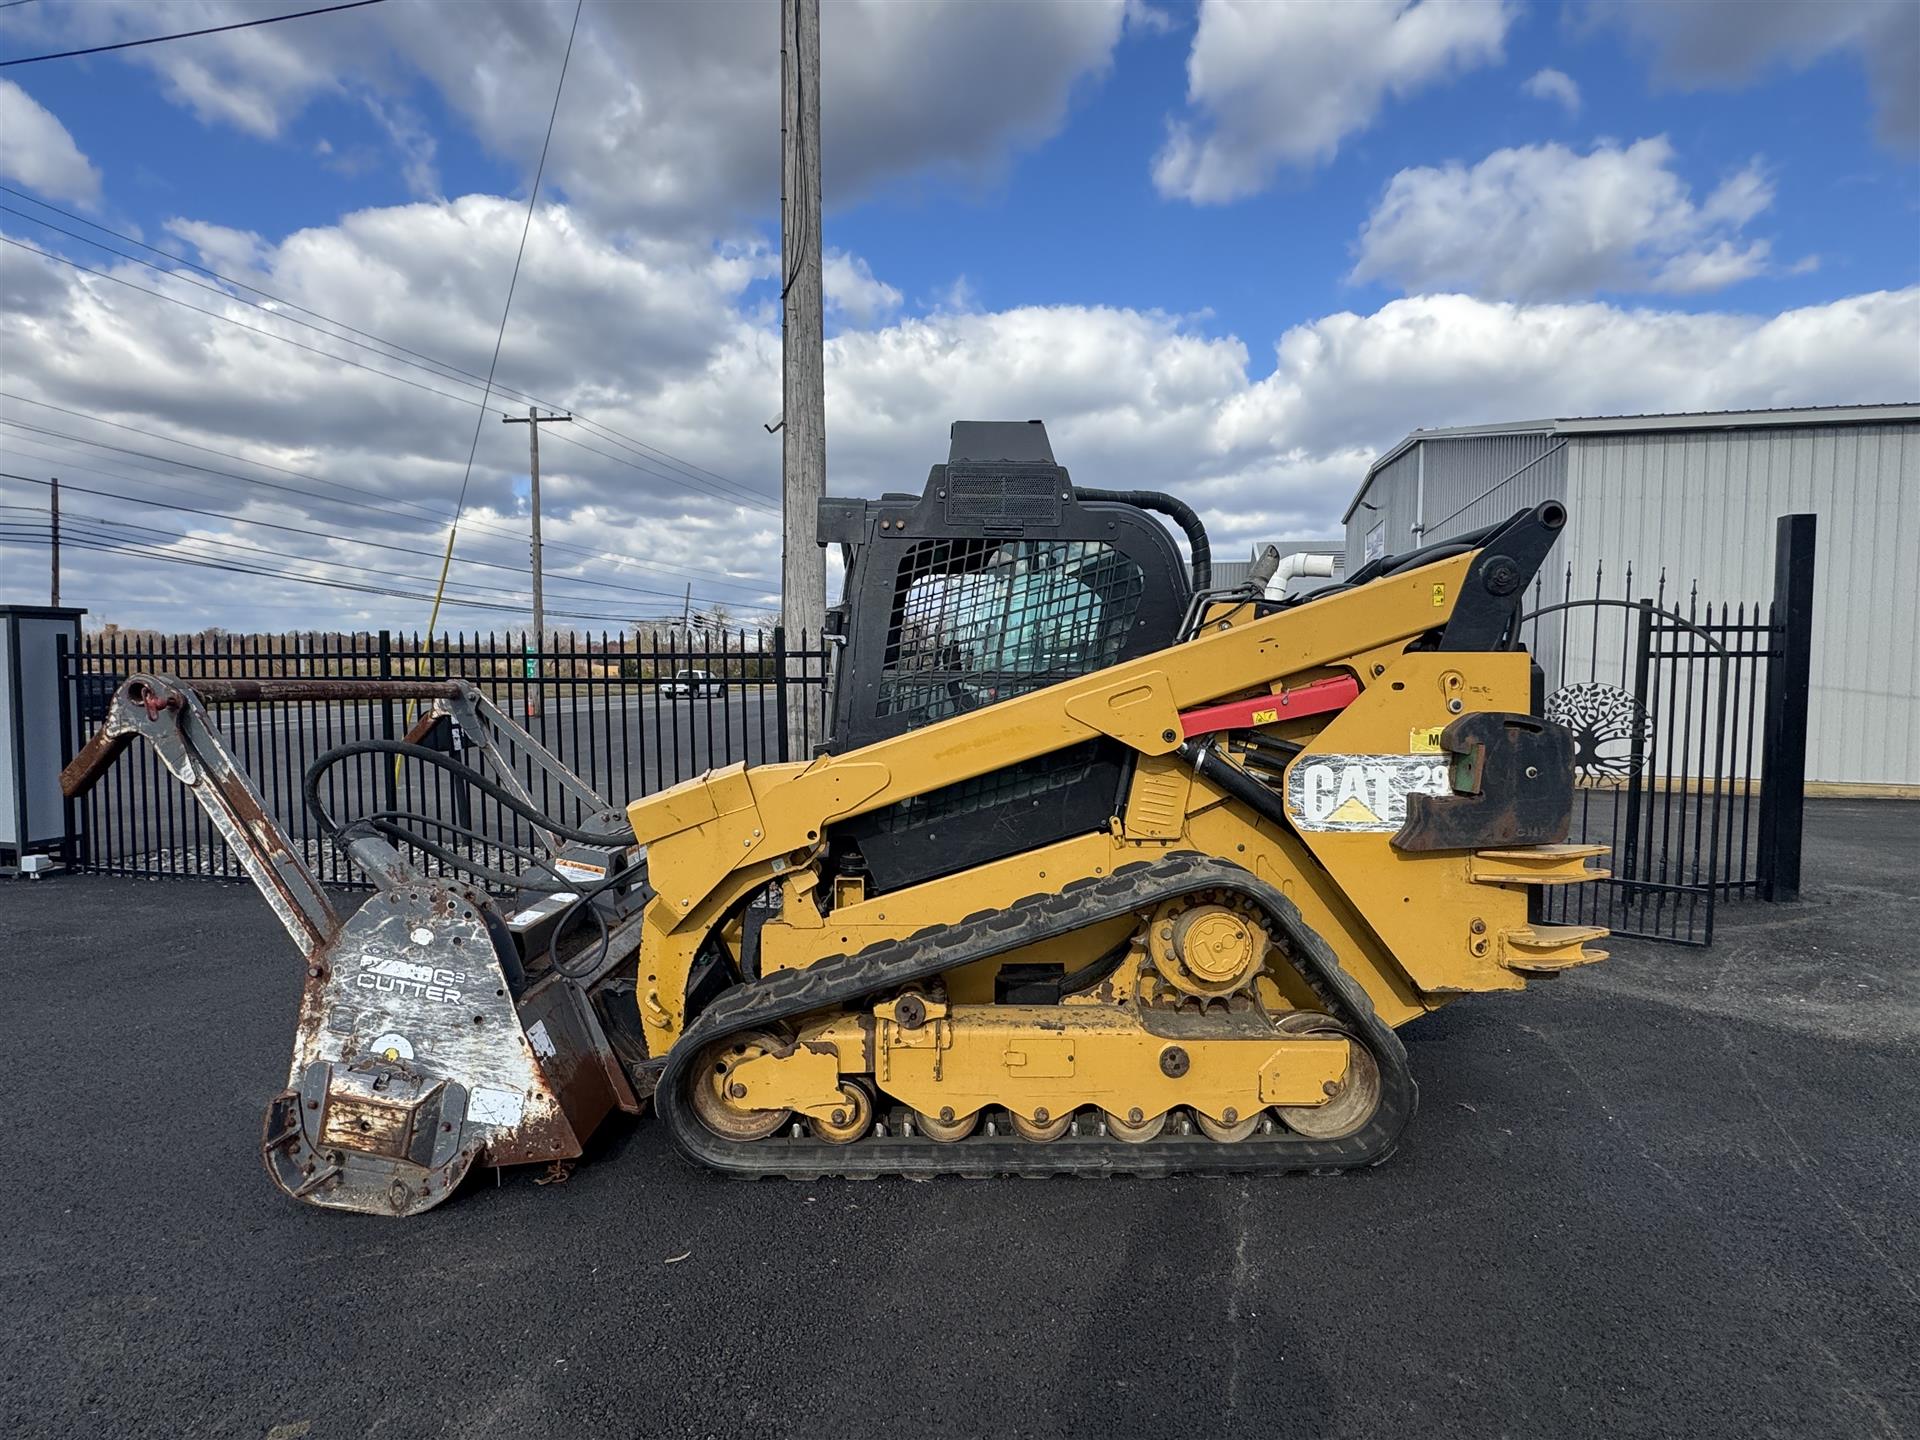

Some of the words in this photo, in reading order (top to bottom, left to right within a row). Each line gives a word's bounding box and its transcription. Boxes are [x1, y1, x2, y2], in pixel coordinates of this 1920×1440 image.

[1428, 734, 1440, 746] M
[1304, 764, 1398, 822] CAT
[1414, 765, 1450, 793] 29
[357, 973, 462, 1005] CUTTER
